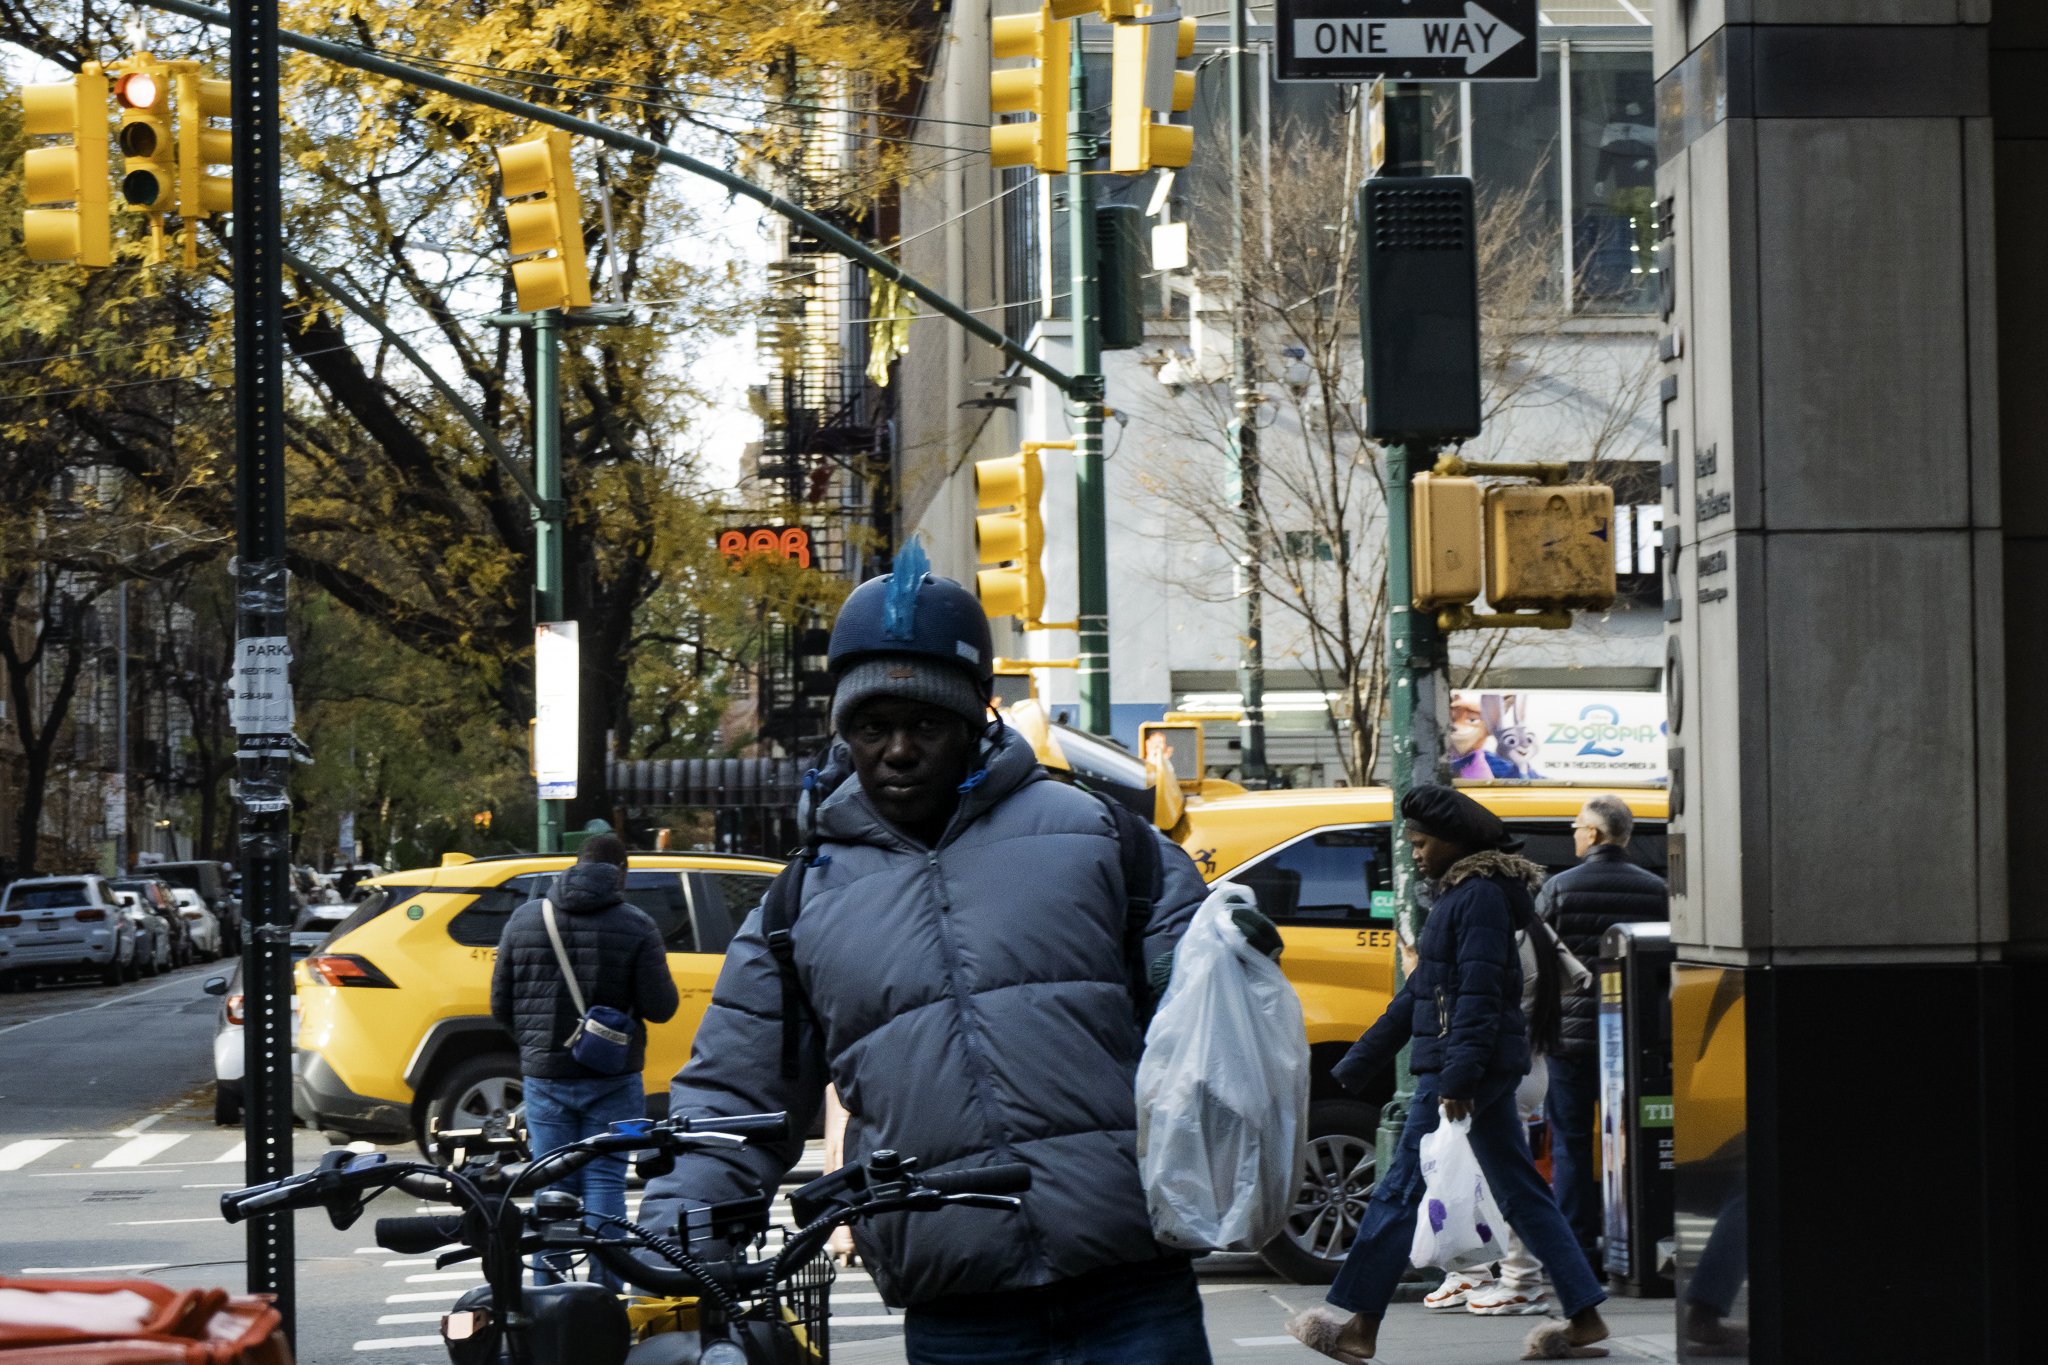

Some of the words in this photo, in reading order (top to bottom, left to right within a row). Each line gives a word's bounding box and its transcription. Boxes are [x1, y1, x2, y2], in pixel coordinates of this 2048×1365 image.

[1315, 23, 1387, 54] ONE
[1423, 23, 1498, 54] WAY
[247, 645, 291, 656] PARK
[1544, 722, 1657, 744] ZOOTOPIA
[1609, 761, 1646, 770] NOVEMBER
